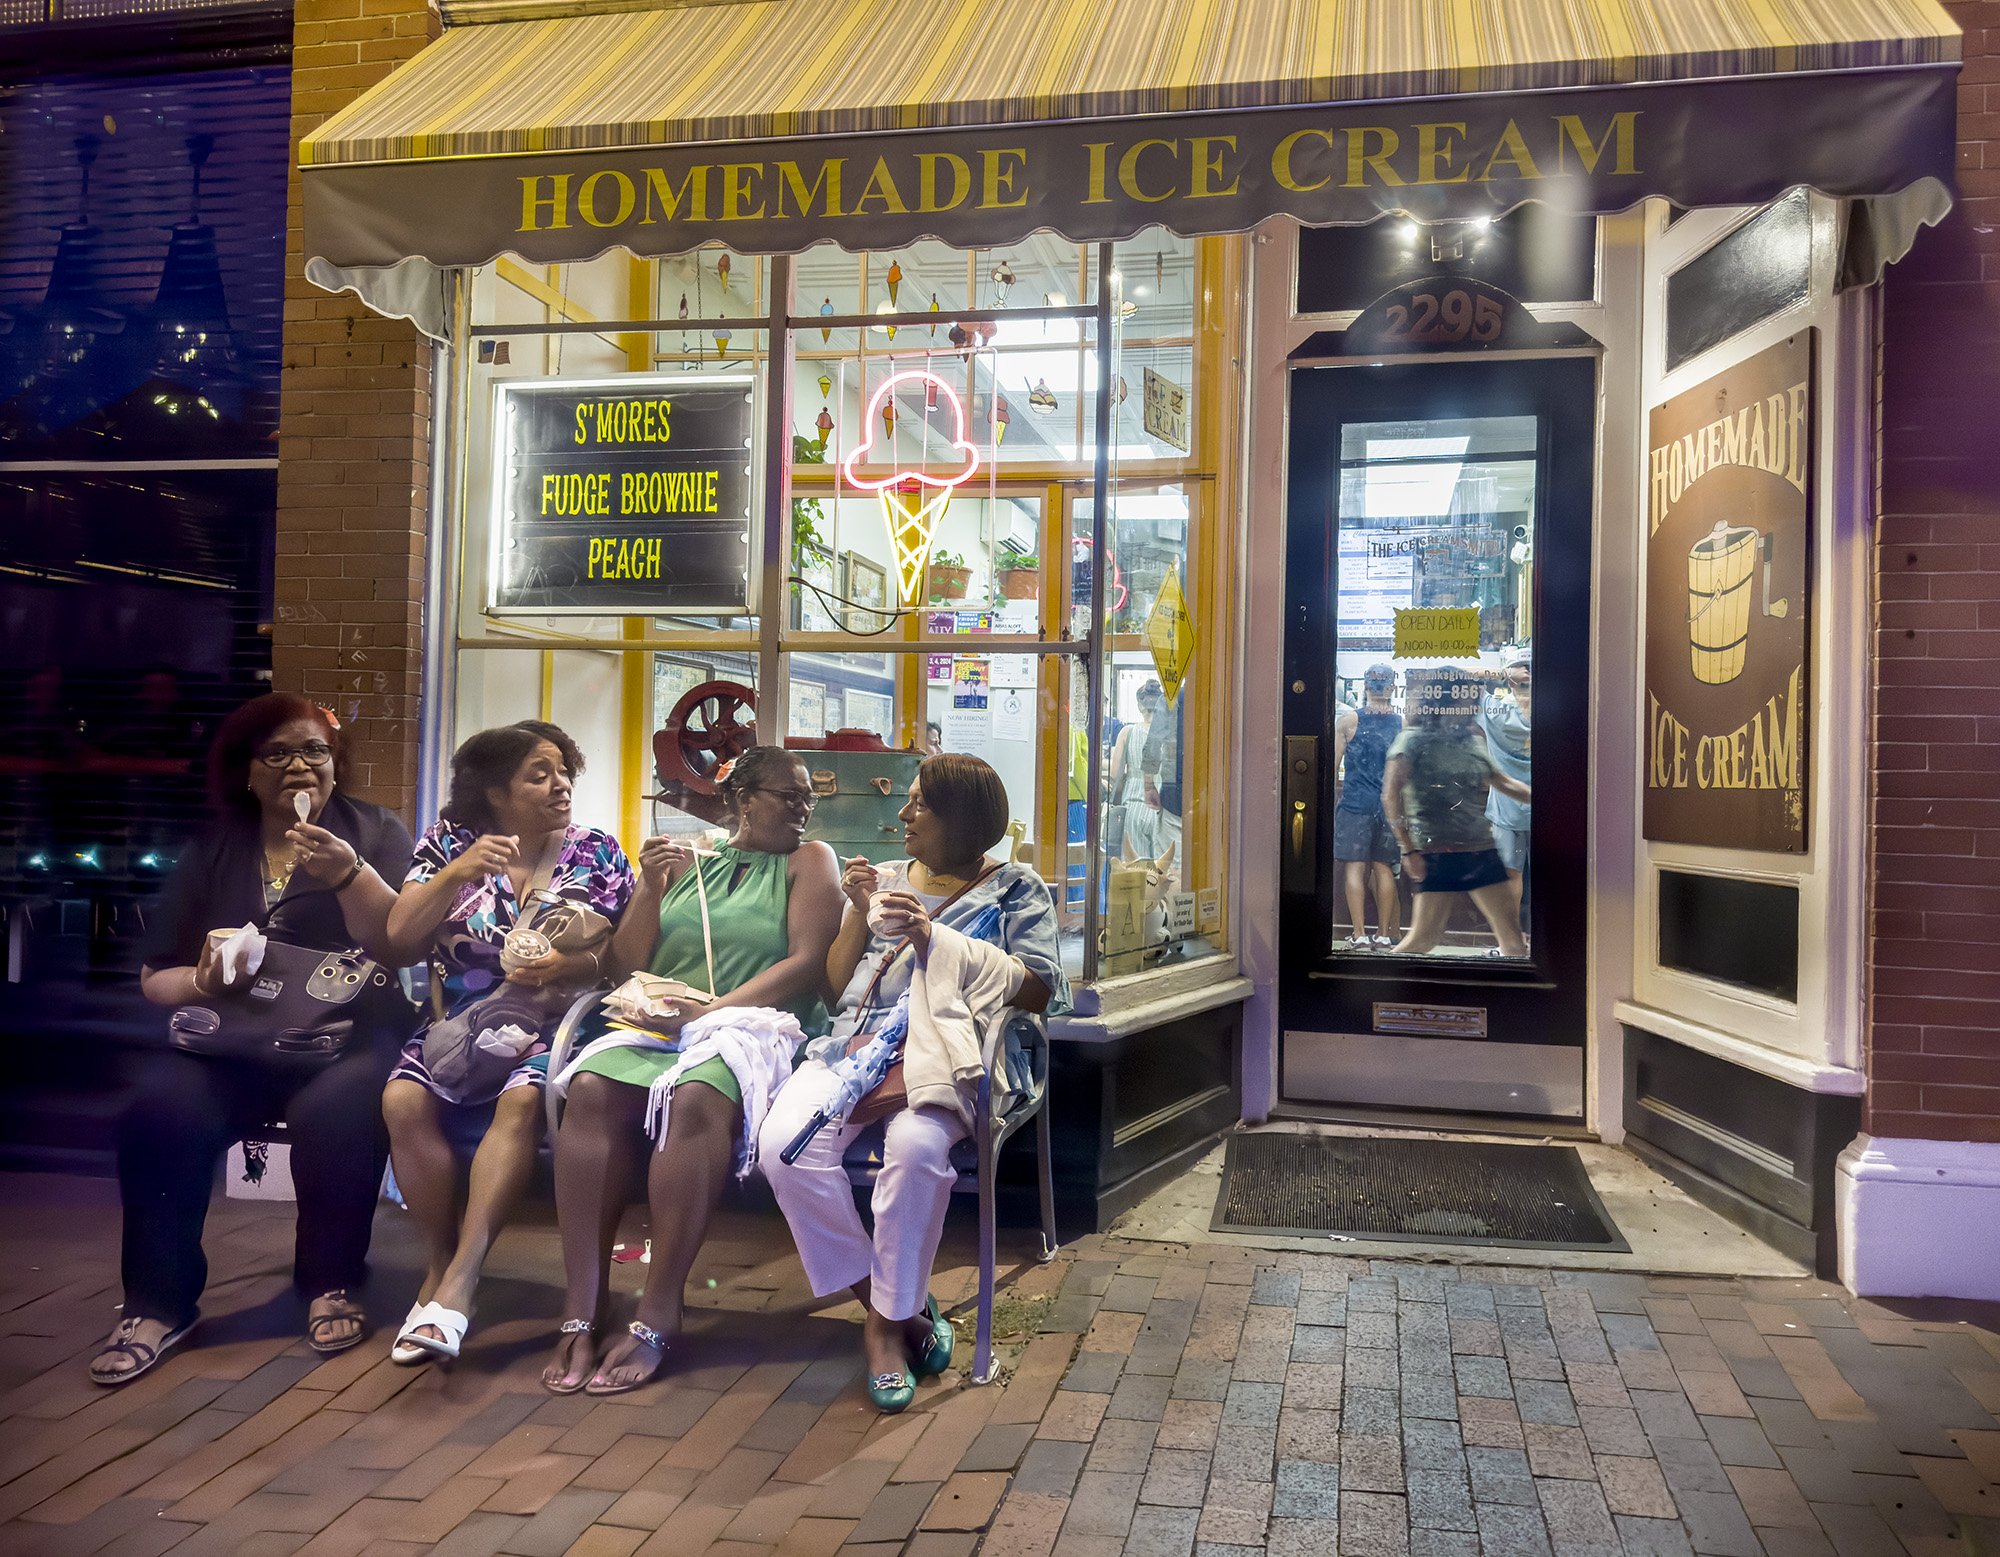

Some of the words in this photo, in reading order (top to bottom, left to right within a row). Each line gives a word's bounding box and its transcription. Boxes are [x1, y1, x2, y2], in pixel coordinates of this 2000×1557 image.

[515, 148, 1030, 232] HOMEMADE
[1080, 135, 1240, 204] ICE
[1271, 111, 1645, 193] CREAM
[1383, 289, 1504, 343] 2295
[575, 400, 671, 444] S'MORES
[1649, 381, 1807, 539] HOMEMADE
[541, 473, 611, 515] FUDGE
[621, 471, 719, 514] BROWNIE
[588, 537, 662, 579] PEACH
[1371, 542, 1394, 557] THE
[1397, 539, 1415, 554] ICE
[1401, 615, 1435, 630] OPEN
[1439, 615, 1475, 631] DAILY
[1648, 688, 1689, 789] ICE
[1695, 664, 1802, 790] CREAM
